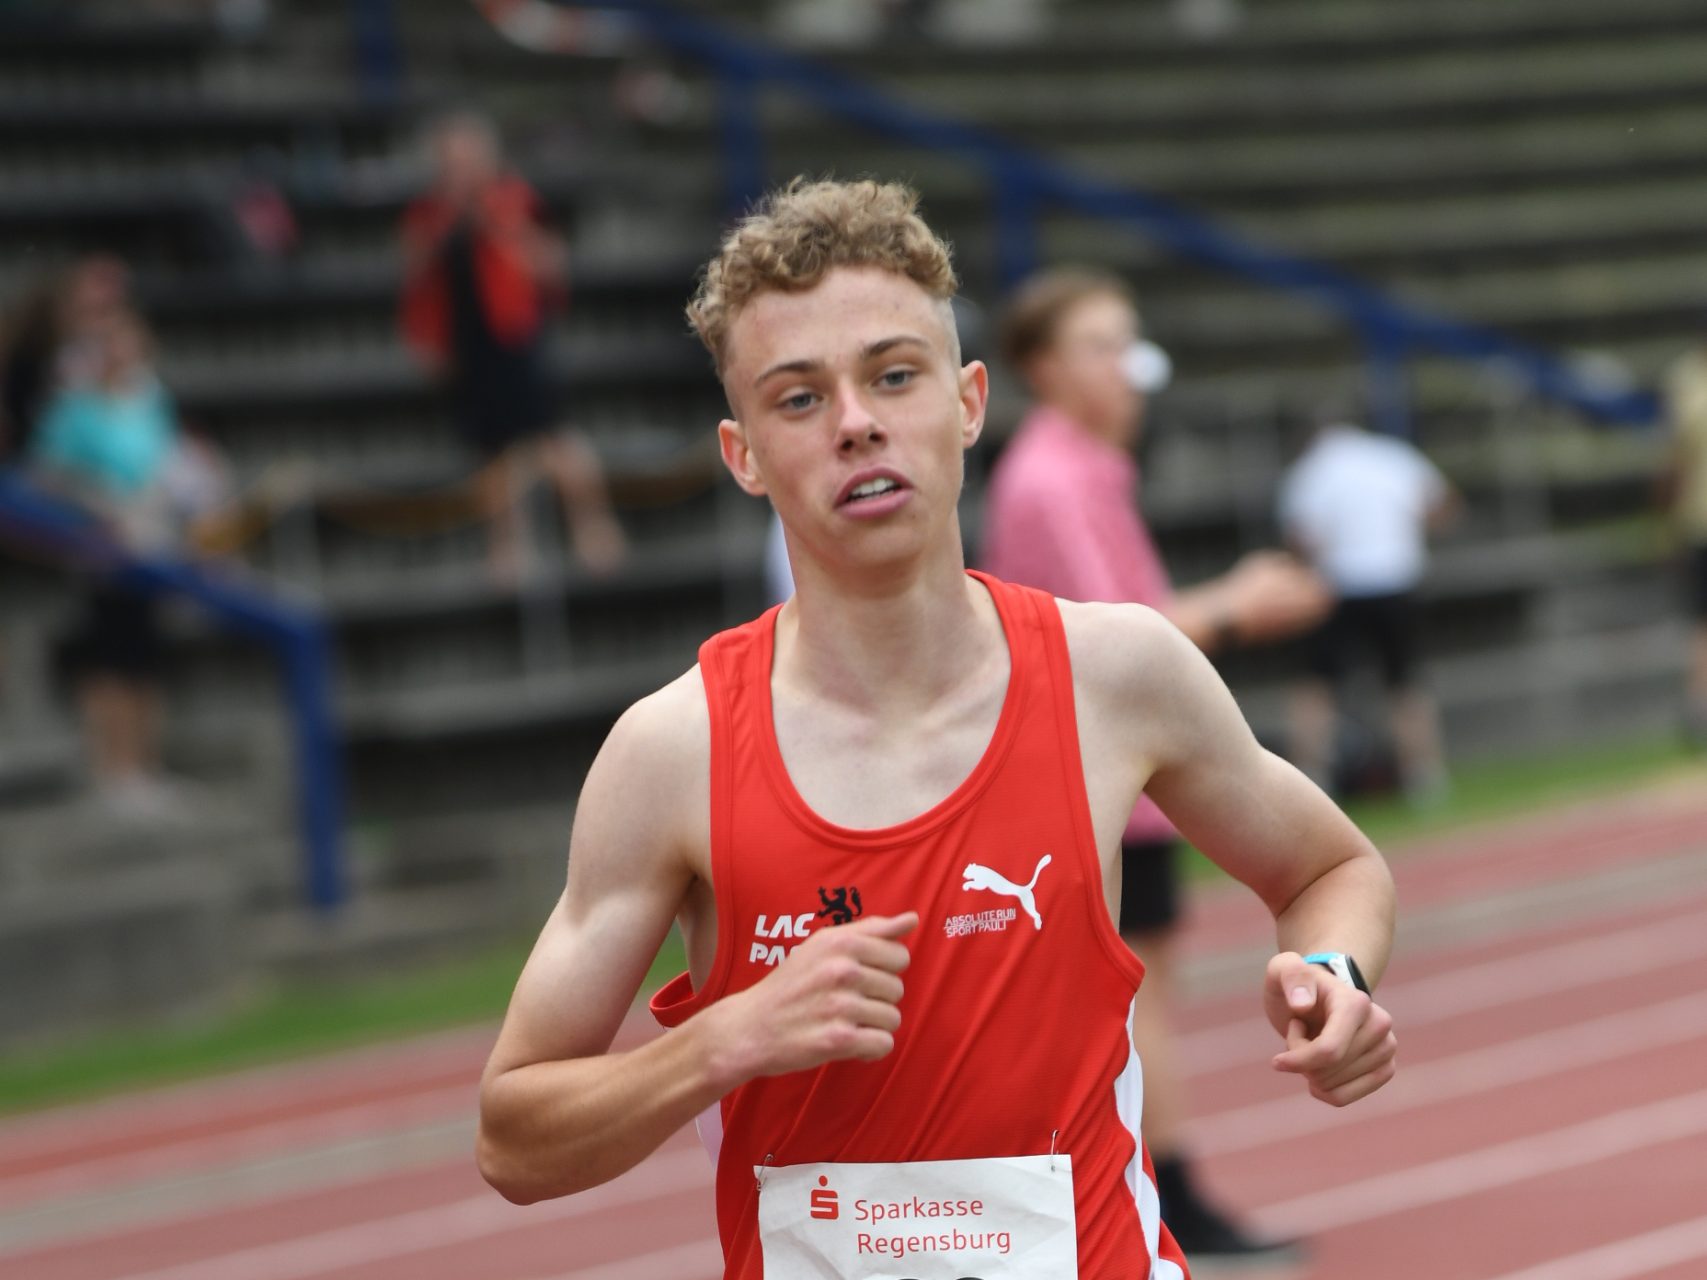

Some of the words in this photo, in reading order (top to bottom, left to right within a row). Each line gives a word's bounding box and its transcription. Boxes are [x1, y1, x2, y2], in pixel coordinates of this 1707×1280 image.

[755, 912, 815, 938] LAC
[945, 909, 995, 927] ABSOLUTE
[946, 923, 978, 938] SPORT
[749, 942, 803, 967] PA
[854, 1196, 984, 1225] Sparkasse
[857, 1228, 1011, 1258] Regensburg
